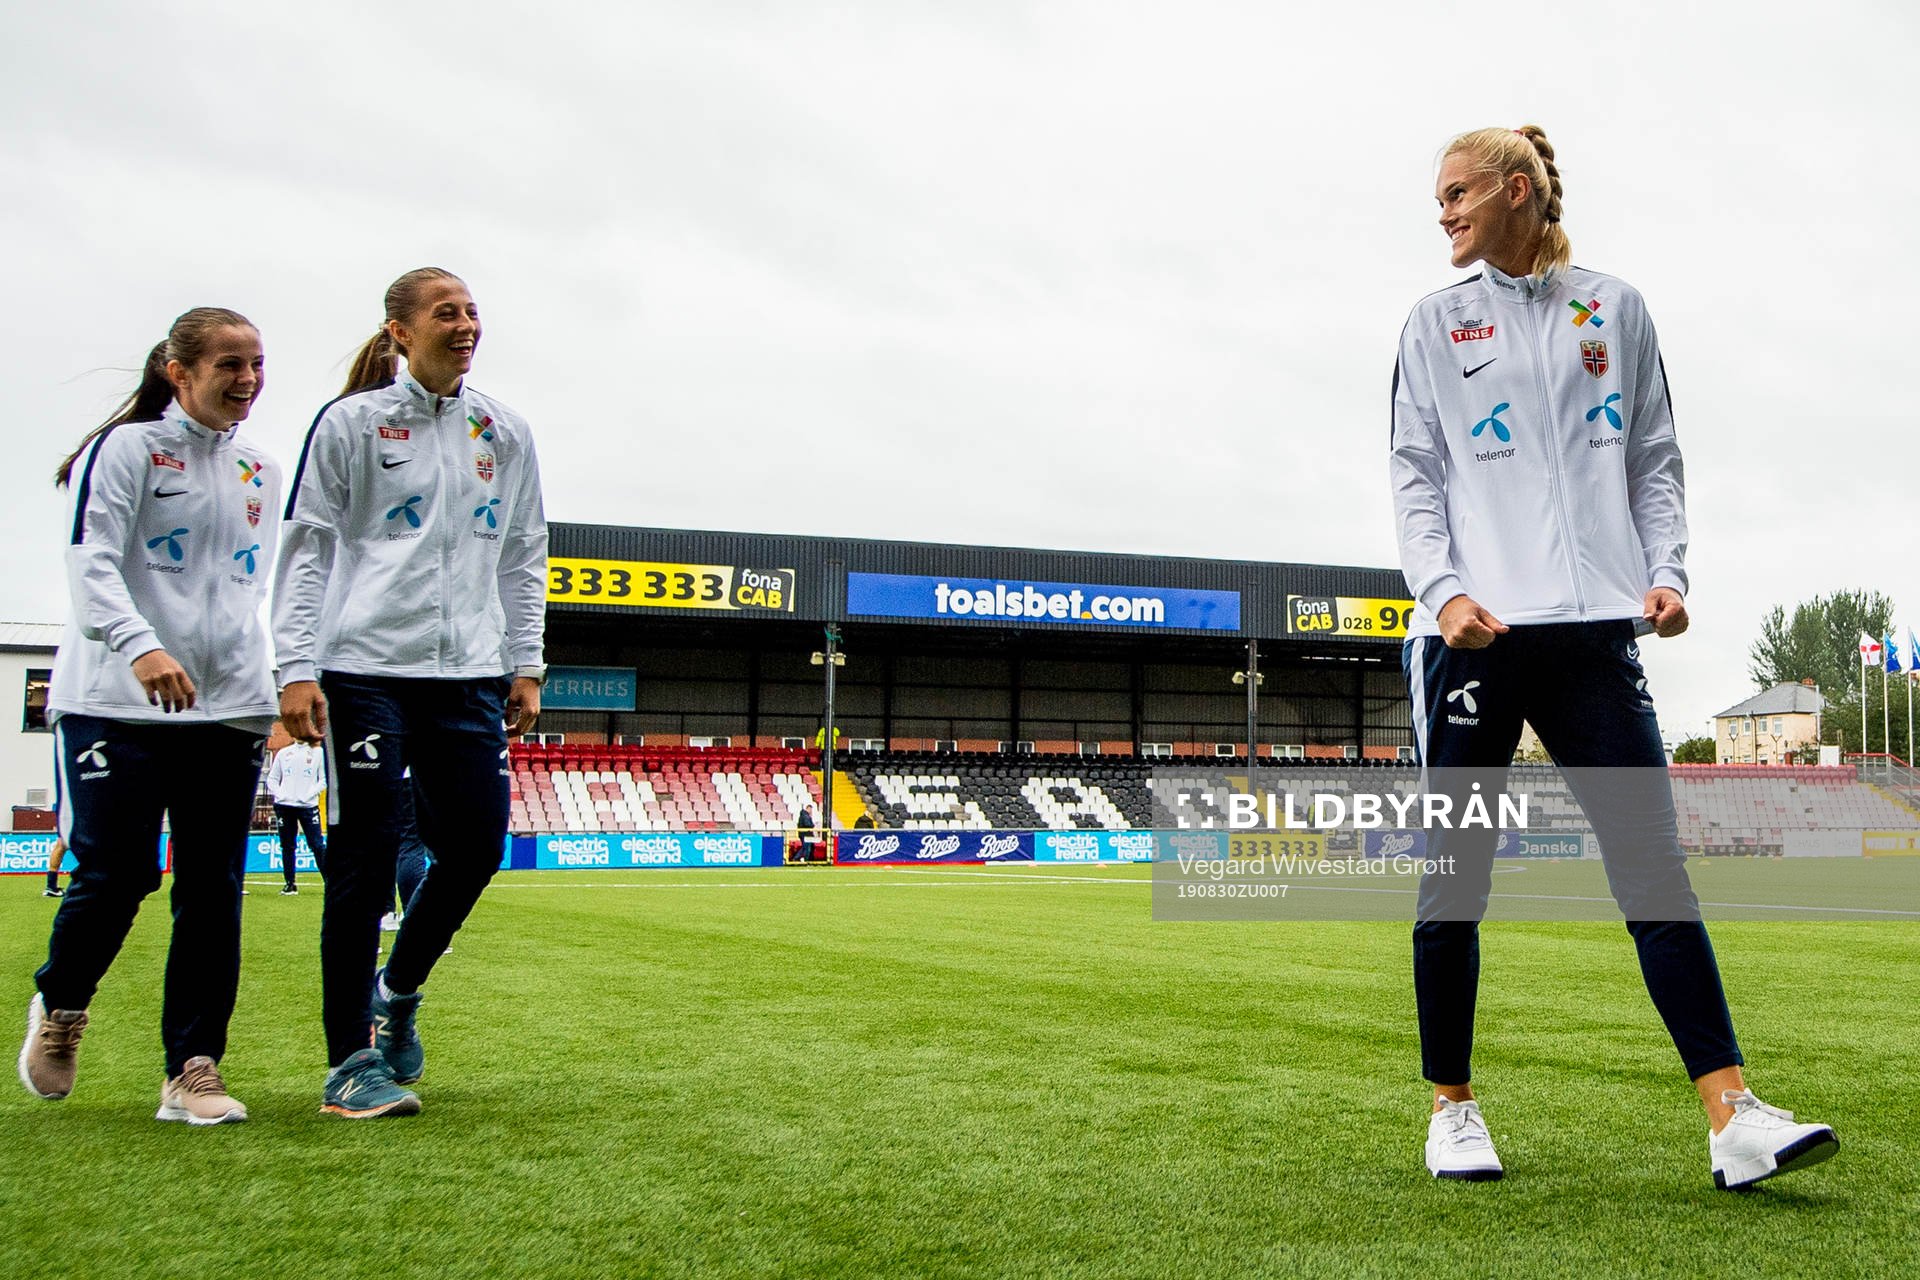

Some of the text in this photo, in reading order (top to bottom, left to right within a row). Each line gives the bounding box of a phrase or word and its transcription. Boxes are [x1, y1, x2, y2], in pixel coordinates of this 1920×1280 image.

[1454, 329, 1491, 341] TINE
[381, 428, 407, 440] TINE
[1589, 436, 1624, 449] teleno
[1475, 447, 1516, 462] telenor
[549, 566, 724, 601] 333 333
[741, 568, 782, 591] fona
[737, 585, 782, 608] CAB
[934, 583, 1164, 622] toalsbet.com
[1296, 599, 1330, 615] fona
[1296, 613, 1333, 631] CAB
[1343, 617, 1373, 631] 028
[1447, 714, 1480, 726] telenor
[0, 837, 57, 854] lectri
[548, 837, 608, 852] electric
[621, 836, 680, 851] electric
[693, 836, 751, 851] electric
[854, 834, 900, 859] Boots
[916, 834, 961, 859] Boots
[976, 834, 1020, 858] Boots
[1046, 834, 1098, 848] electric
[1108, 834, 1159, 848] electric
[1169, 834, 1218, 848] electric
[1378, 833, 1415, 856] Boots
[1519, 840, 1579, 855] Danske
[632, 849, 681, 864] Ireland
[704, 849, 751, 863] Ireland
[1055, 847, 1099, 860] Ireland
[1117, 846, 1160, 860] Ireland
[1231, 840, 1319, 858] 333 333
[0, 854, 51, 870] Irelan
[558, 850, 609, 865] Ireland
